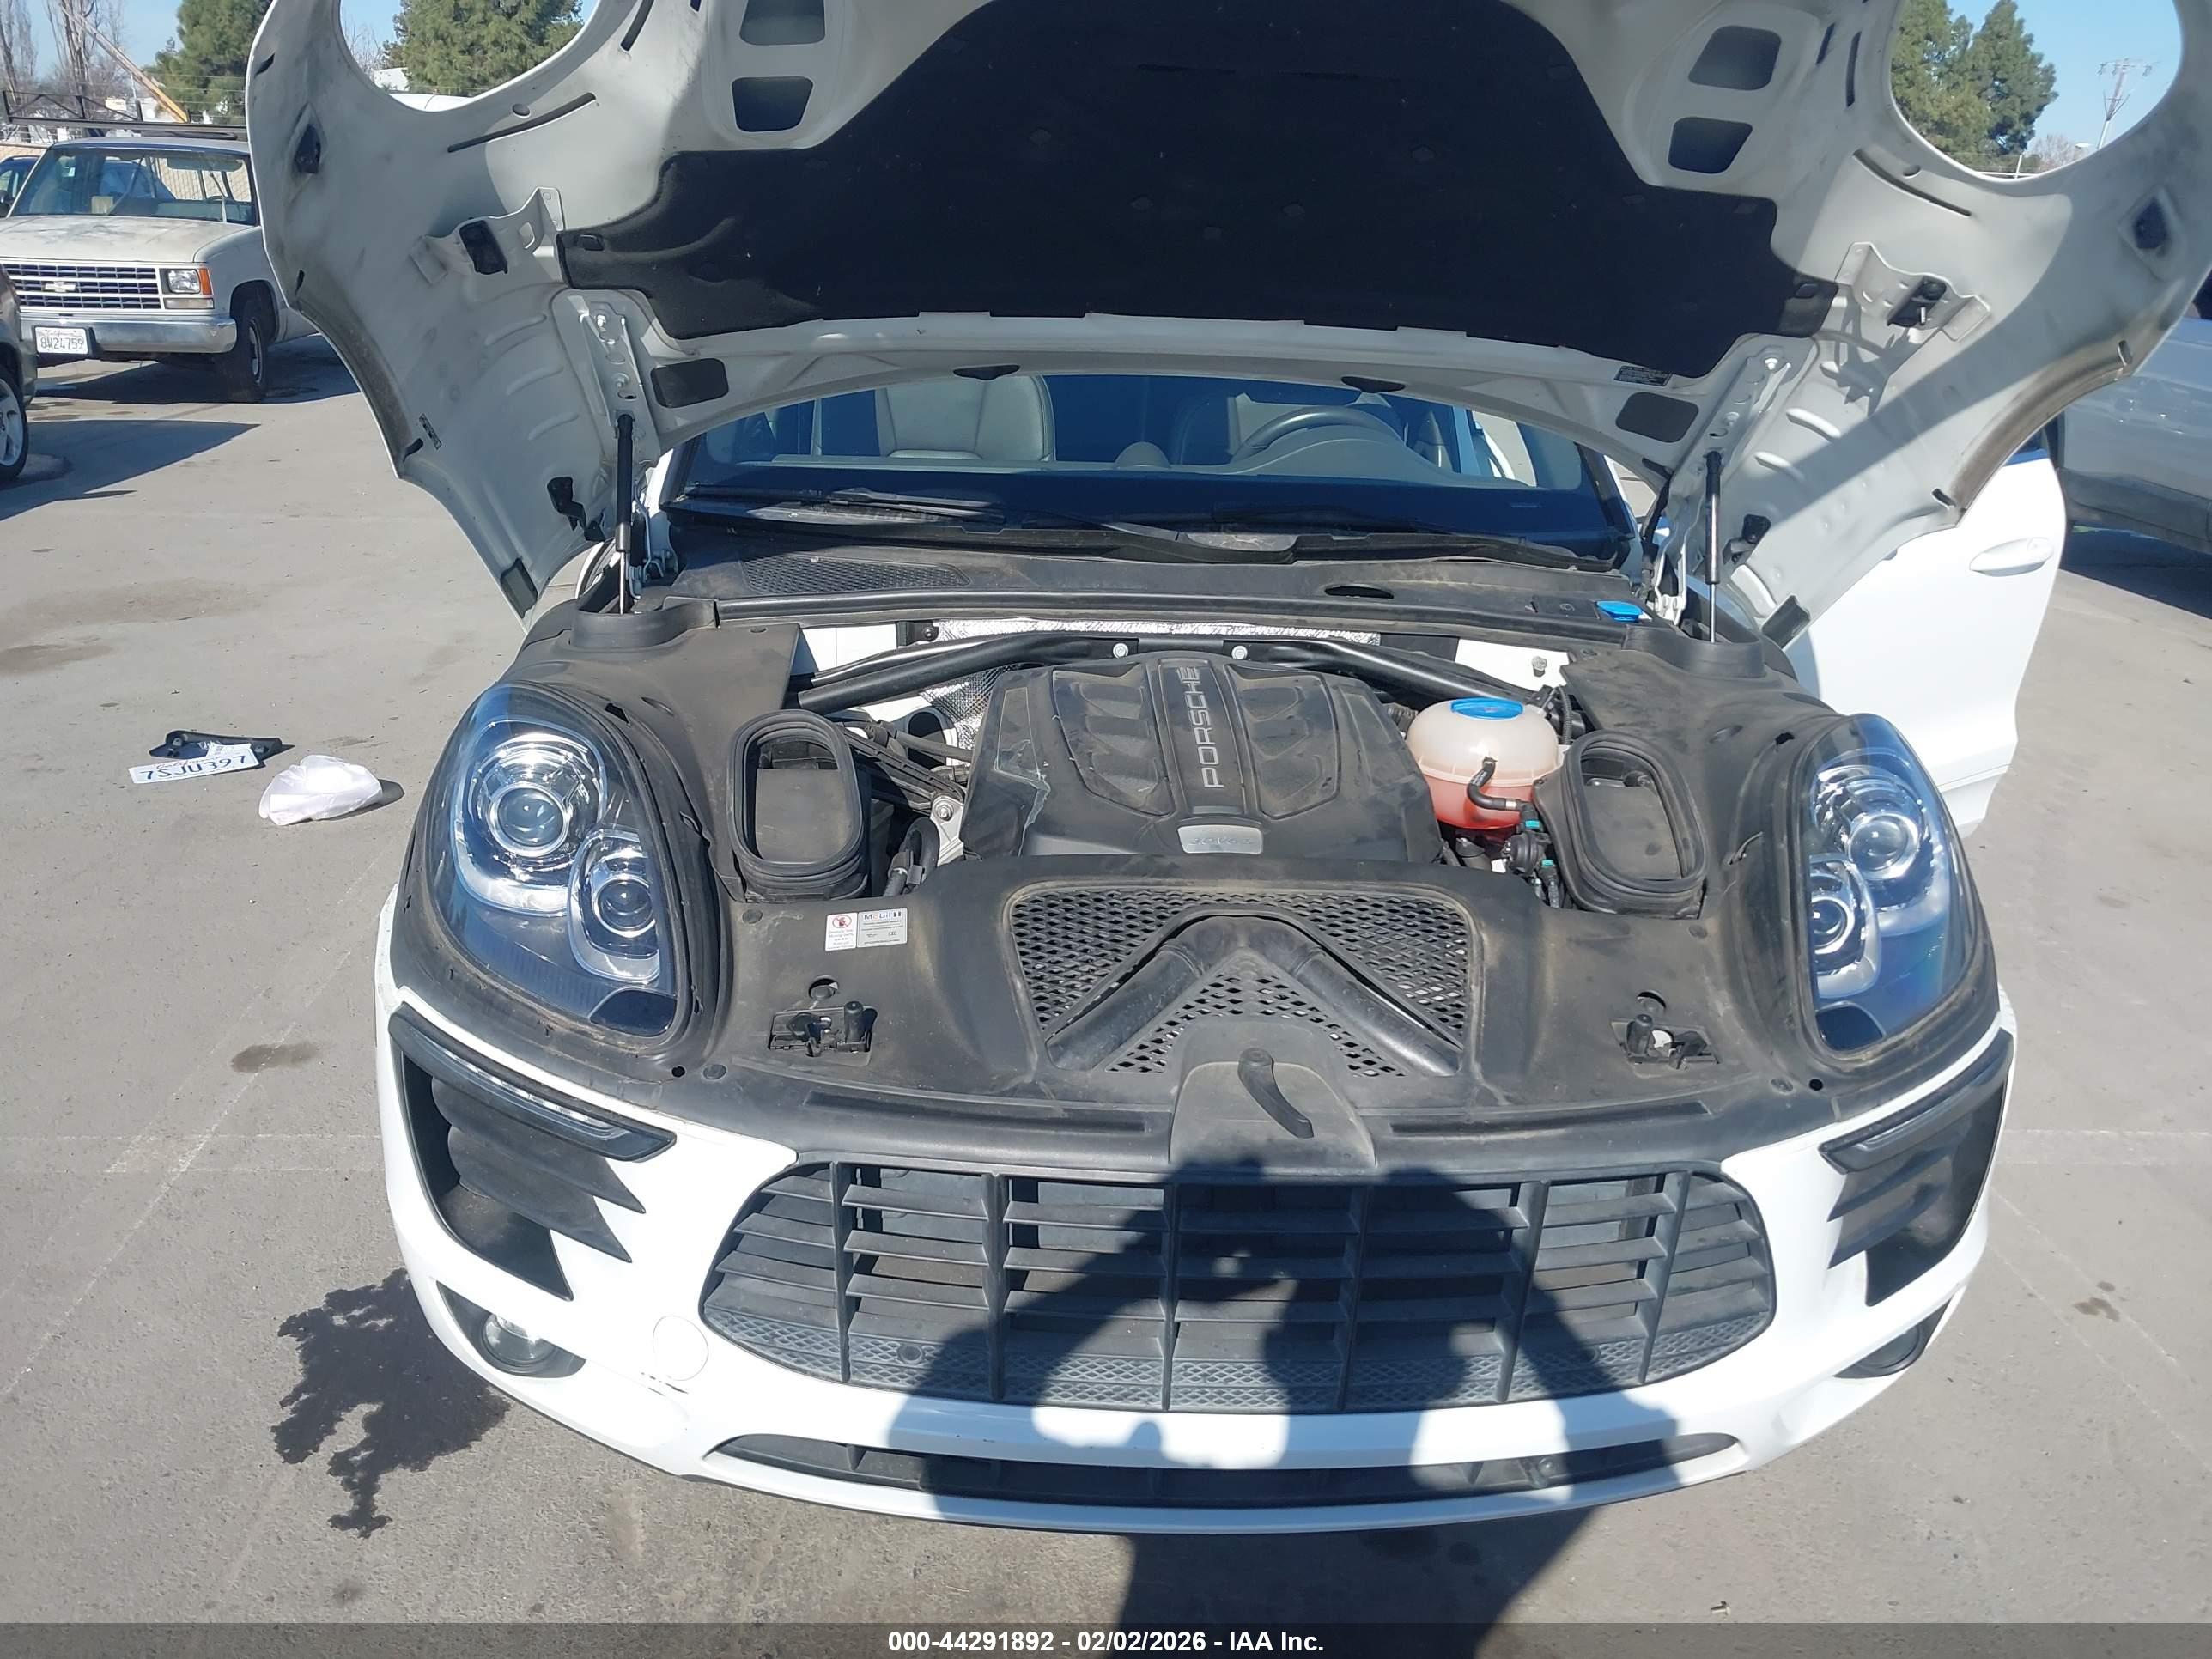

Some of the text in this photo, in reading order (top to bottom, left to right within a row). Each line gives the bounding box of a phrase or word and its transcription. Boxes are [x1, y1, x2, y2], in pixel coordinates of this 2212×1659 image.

[1176, 666, 1225, 788] PORSCHE
[140, 755, 246, 780] 7SJU397
[864, 912, 891, 921] Mobil
